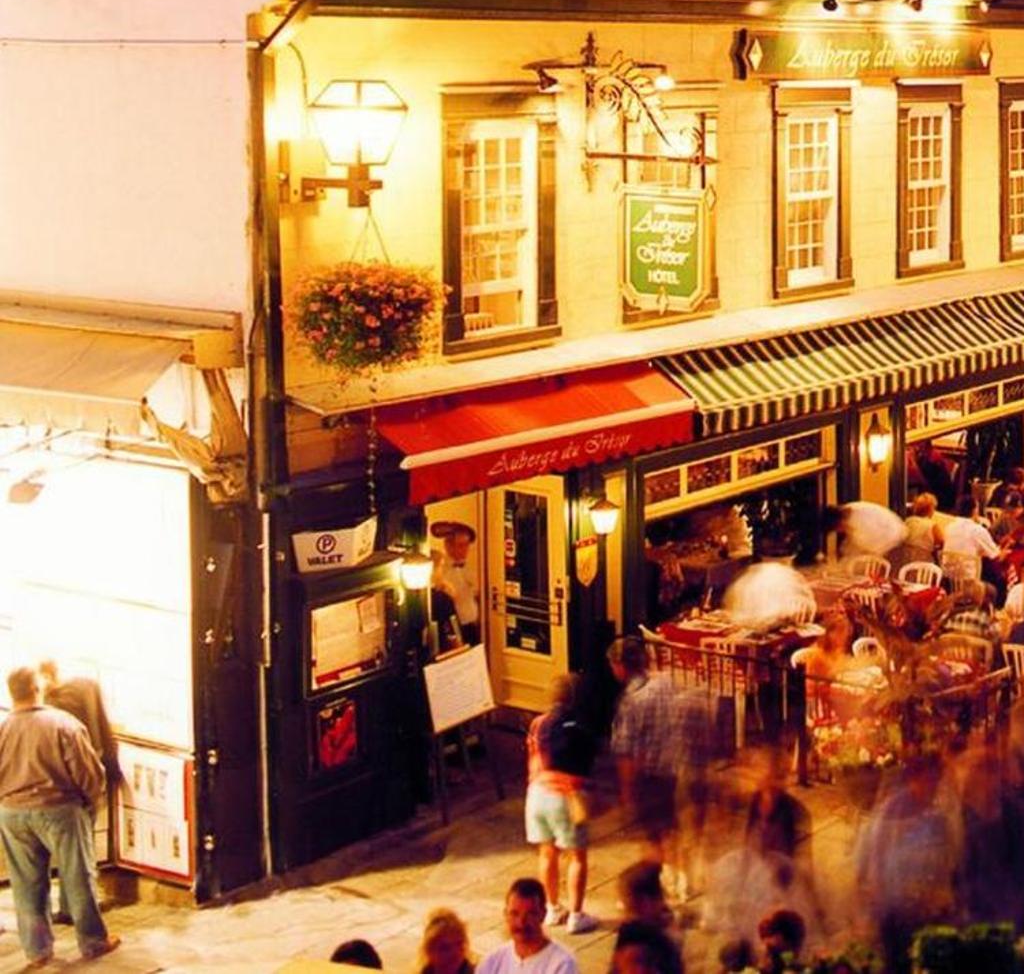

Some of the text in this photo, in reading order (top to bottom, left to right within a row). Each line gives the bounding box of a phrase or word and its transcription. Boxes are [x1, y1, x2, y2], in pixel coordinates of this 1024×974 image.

[786, 39, 872, 77] Auberge
[873, 40, 897, 68] du
[632, 209, 697, 244] Auberge
[487, 449, 559, 475] Auberge
[560, 440, 582, 460] du
[307, 554, 344, 566] VALET
